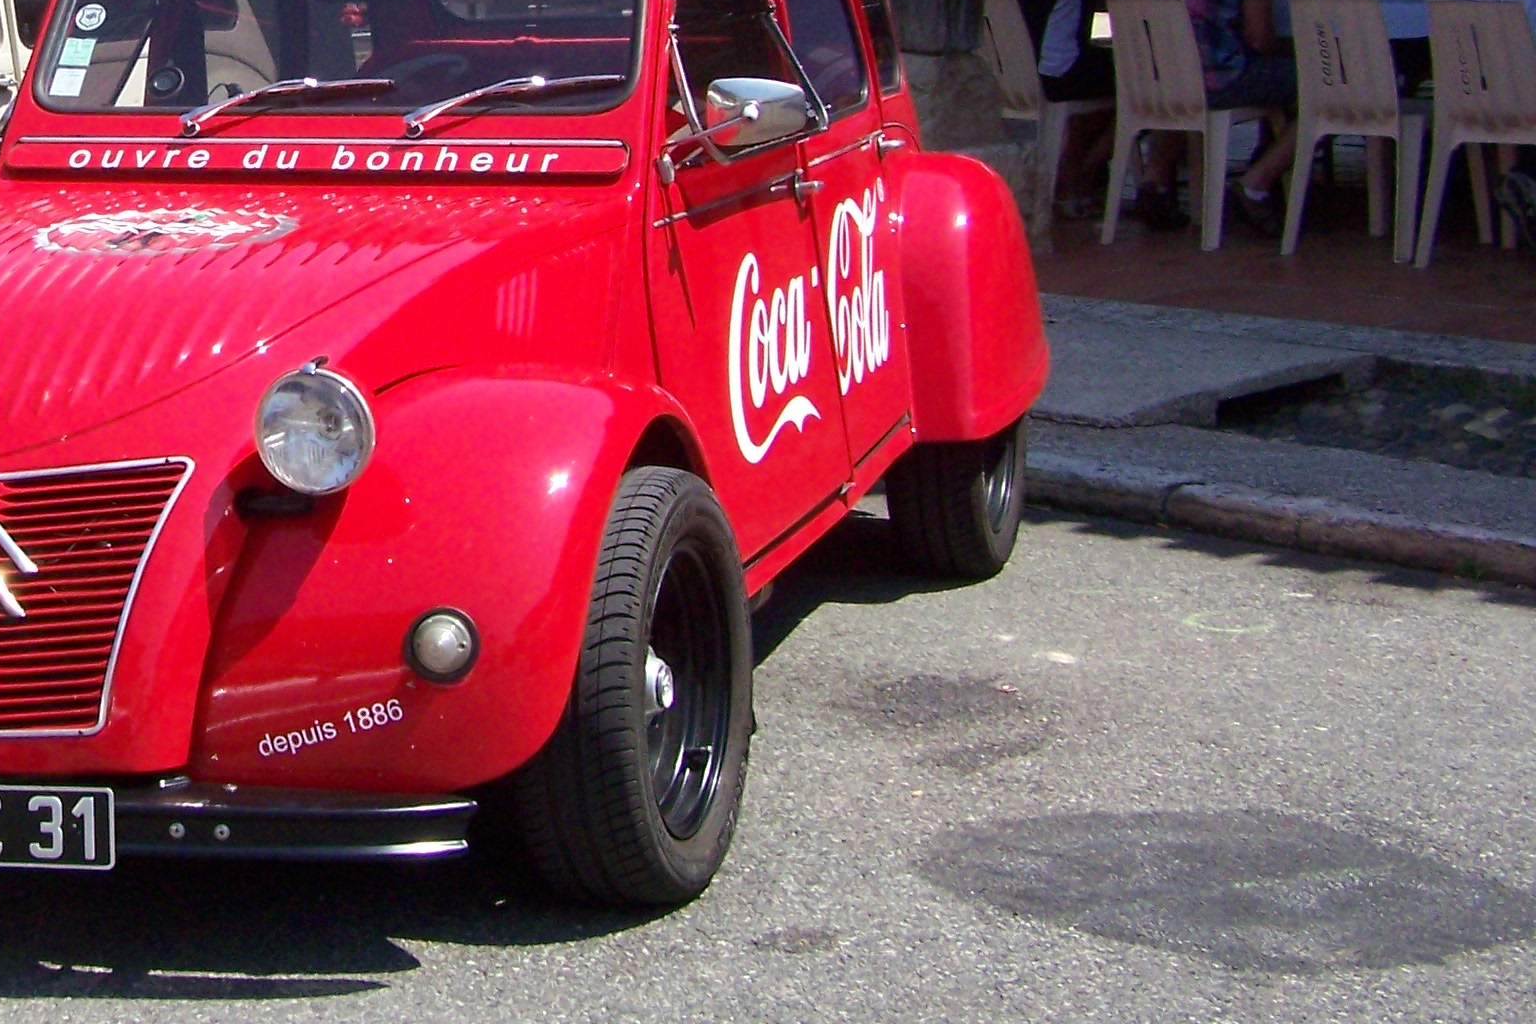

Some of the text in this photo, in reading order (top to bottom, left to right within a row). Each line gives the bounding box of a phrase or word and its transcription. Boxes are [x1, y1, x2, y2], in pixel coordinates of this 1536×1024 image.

[68, 145, 559, 172] ouvre du bonheur
[258, 699, 403, 756] depuis 1886
[28, 795, 95, 860] 31
